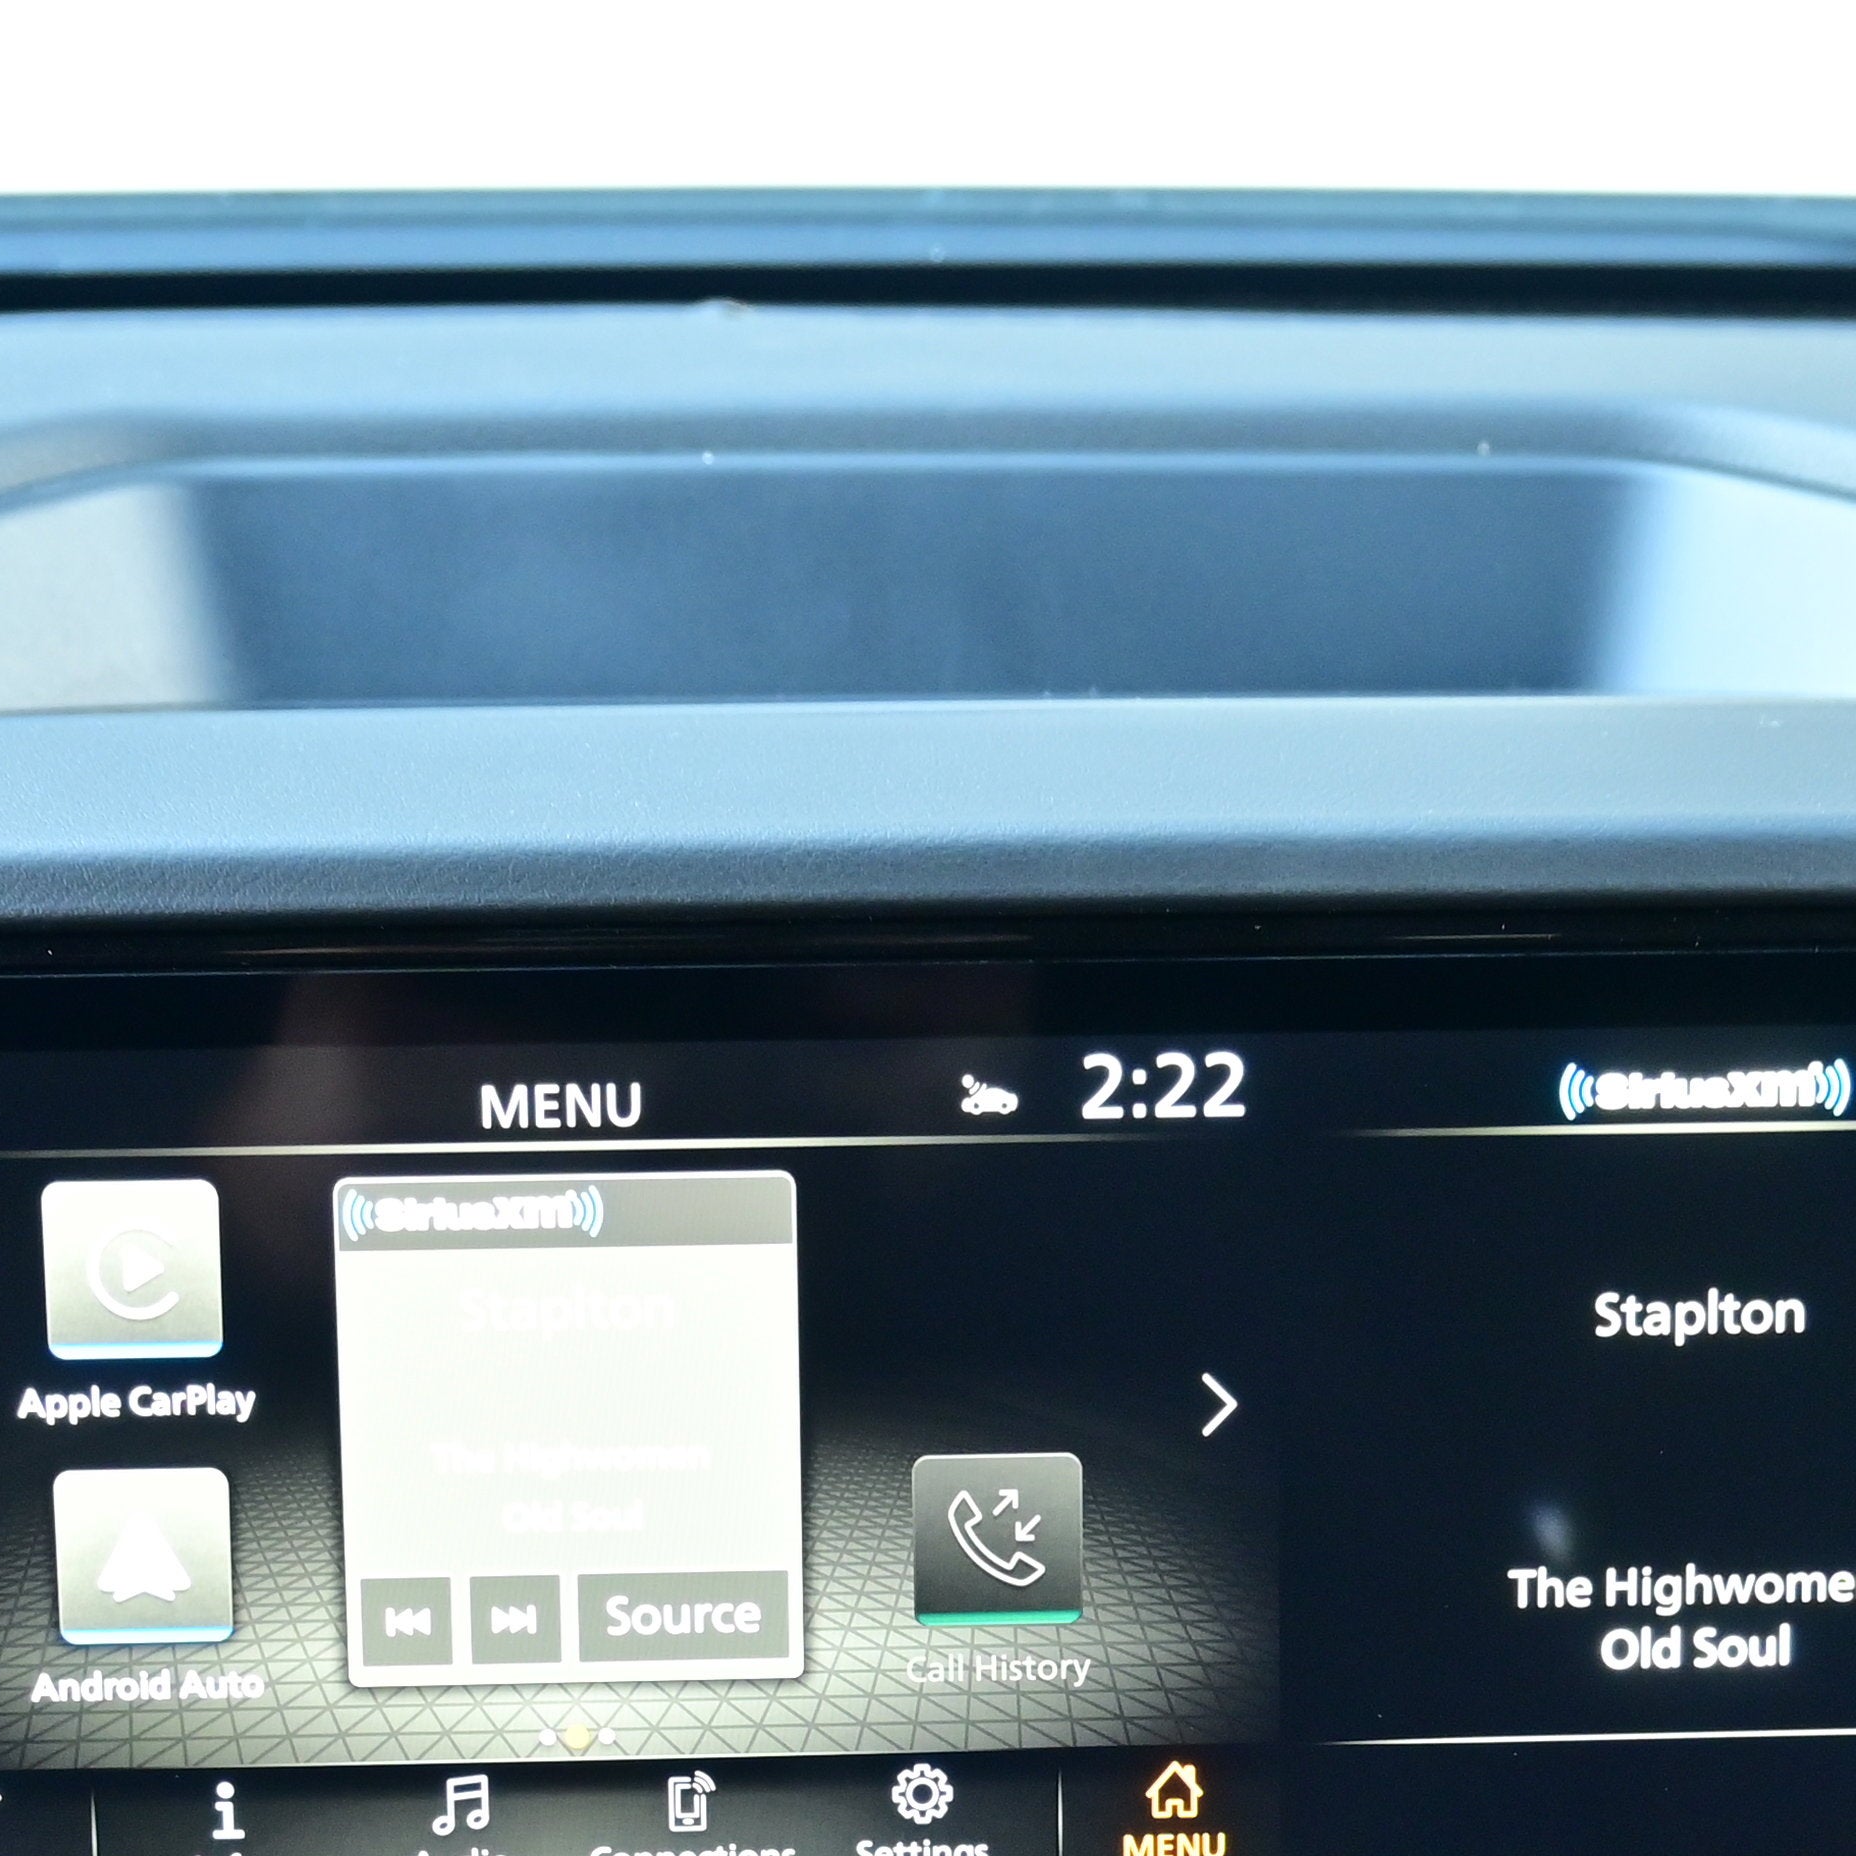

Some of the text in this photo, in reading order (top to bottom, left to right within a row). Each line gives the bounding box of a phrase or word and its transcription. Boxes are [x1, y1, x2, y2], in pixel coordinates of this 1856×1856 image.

[481, 1082, 642, 1129] MENU
[1081, 1051, 1246, 1119] 2:22
[1594, 1288, 1806, 1346] Staplton
[17, 1382, 257, 1425] Apple CarPlay
[1507, 1566, 1593, 1609] The
[605, 1594, 762, 1637] Source
[1600, 1624, 1792, 1670] Old Soul
[30, 1669, 265, 1703] Android Auto
[906, 1656, 1092, 1688] Call History
